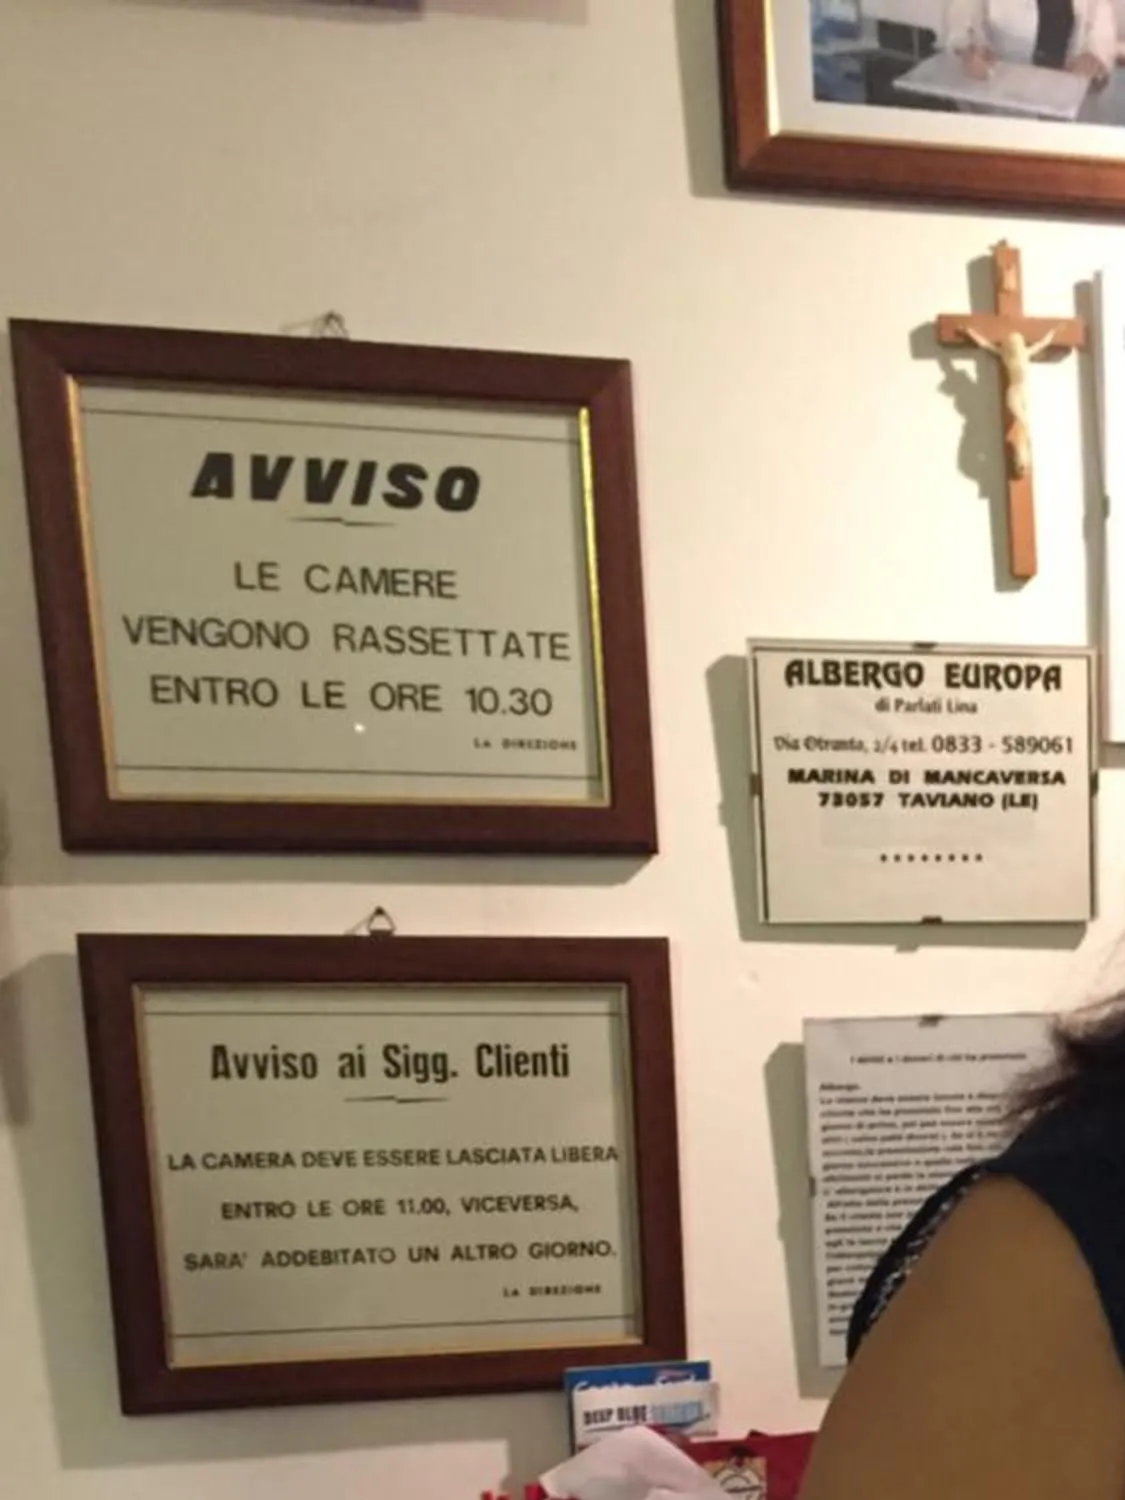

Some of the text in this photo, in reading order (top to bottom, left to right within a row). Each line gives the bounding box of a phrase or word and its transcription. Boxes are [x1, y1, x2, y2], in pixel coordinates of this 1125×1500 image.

[191, 452, 481, 513] AVVISO
[234, 561, 458, 599] LE CAMERE
[122, 615, 571, 661] VENGONO RASSETTATE
[785, 659, 1062, 692] ALBERGO EUROPA
[151, 676, 553, 717] ENTRO LE ORE 10.30
[875, 697, 978, 714] di Parlati Lina
[932, 736, 983, 754] 0833
[1002, 737, 1074, 755] 589061
[788, 769, 1066, 786] MARINA DI MANCAVERSA
[818, 792, 1039, 811] 73057 TAVIANO (LE)
[211, 1043, 569, 1084] Avviso ai Sigg. Clienti
[168, 1146, 618, 1171] LA CAMERA DEVE ESSERE LASCIATA LIBERA
[221, 1195, 578, 1220] ENTRO LE ORE 11.00, VICEVERSA,
[183, 1241, 616, 1271] SARA' ADDEBITATO UN ALTRO GIORNO.
